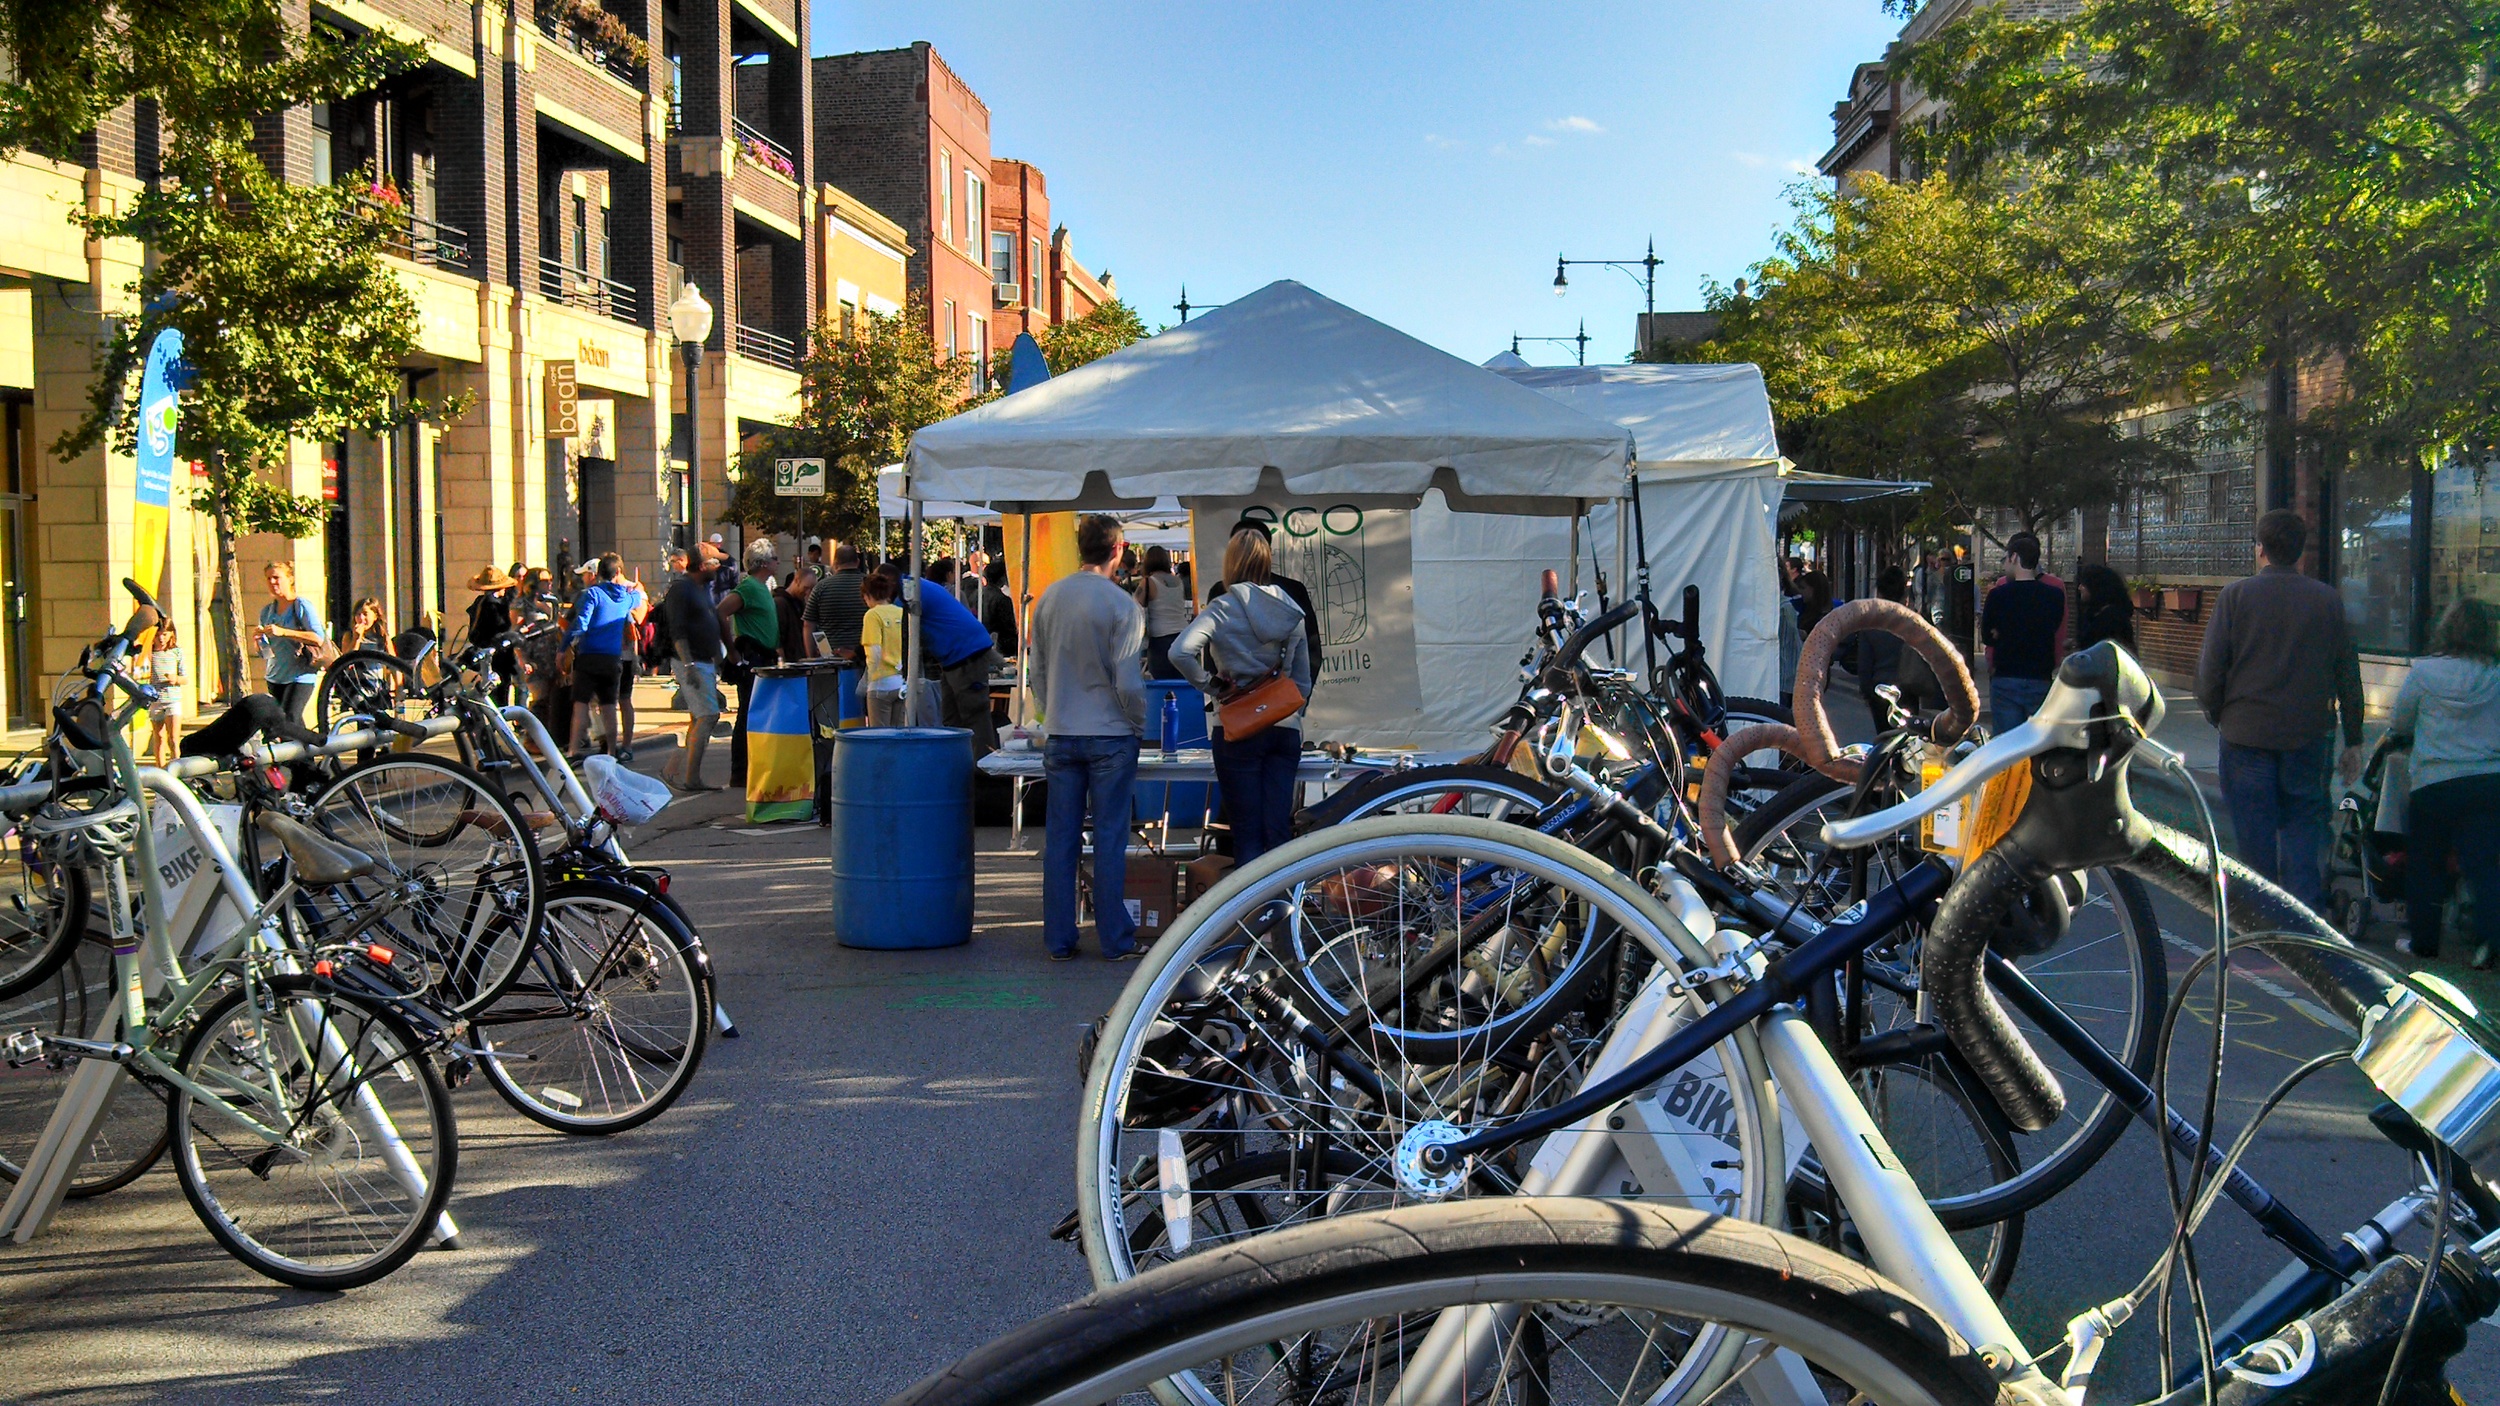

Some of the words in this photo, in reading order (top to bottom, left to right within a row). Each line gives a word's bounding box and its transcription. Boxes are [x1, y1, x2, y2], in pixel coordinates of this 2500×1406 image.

[1240, 504, 1363, 538] eco
[1322, 676, 1361, 686] prosperity
[1663, 1070, 1740, 1151] BIK
